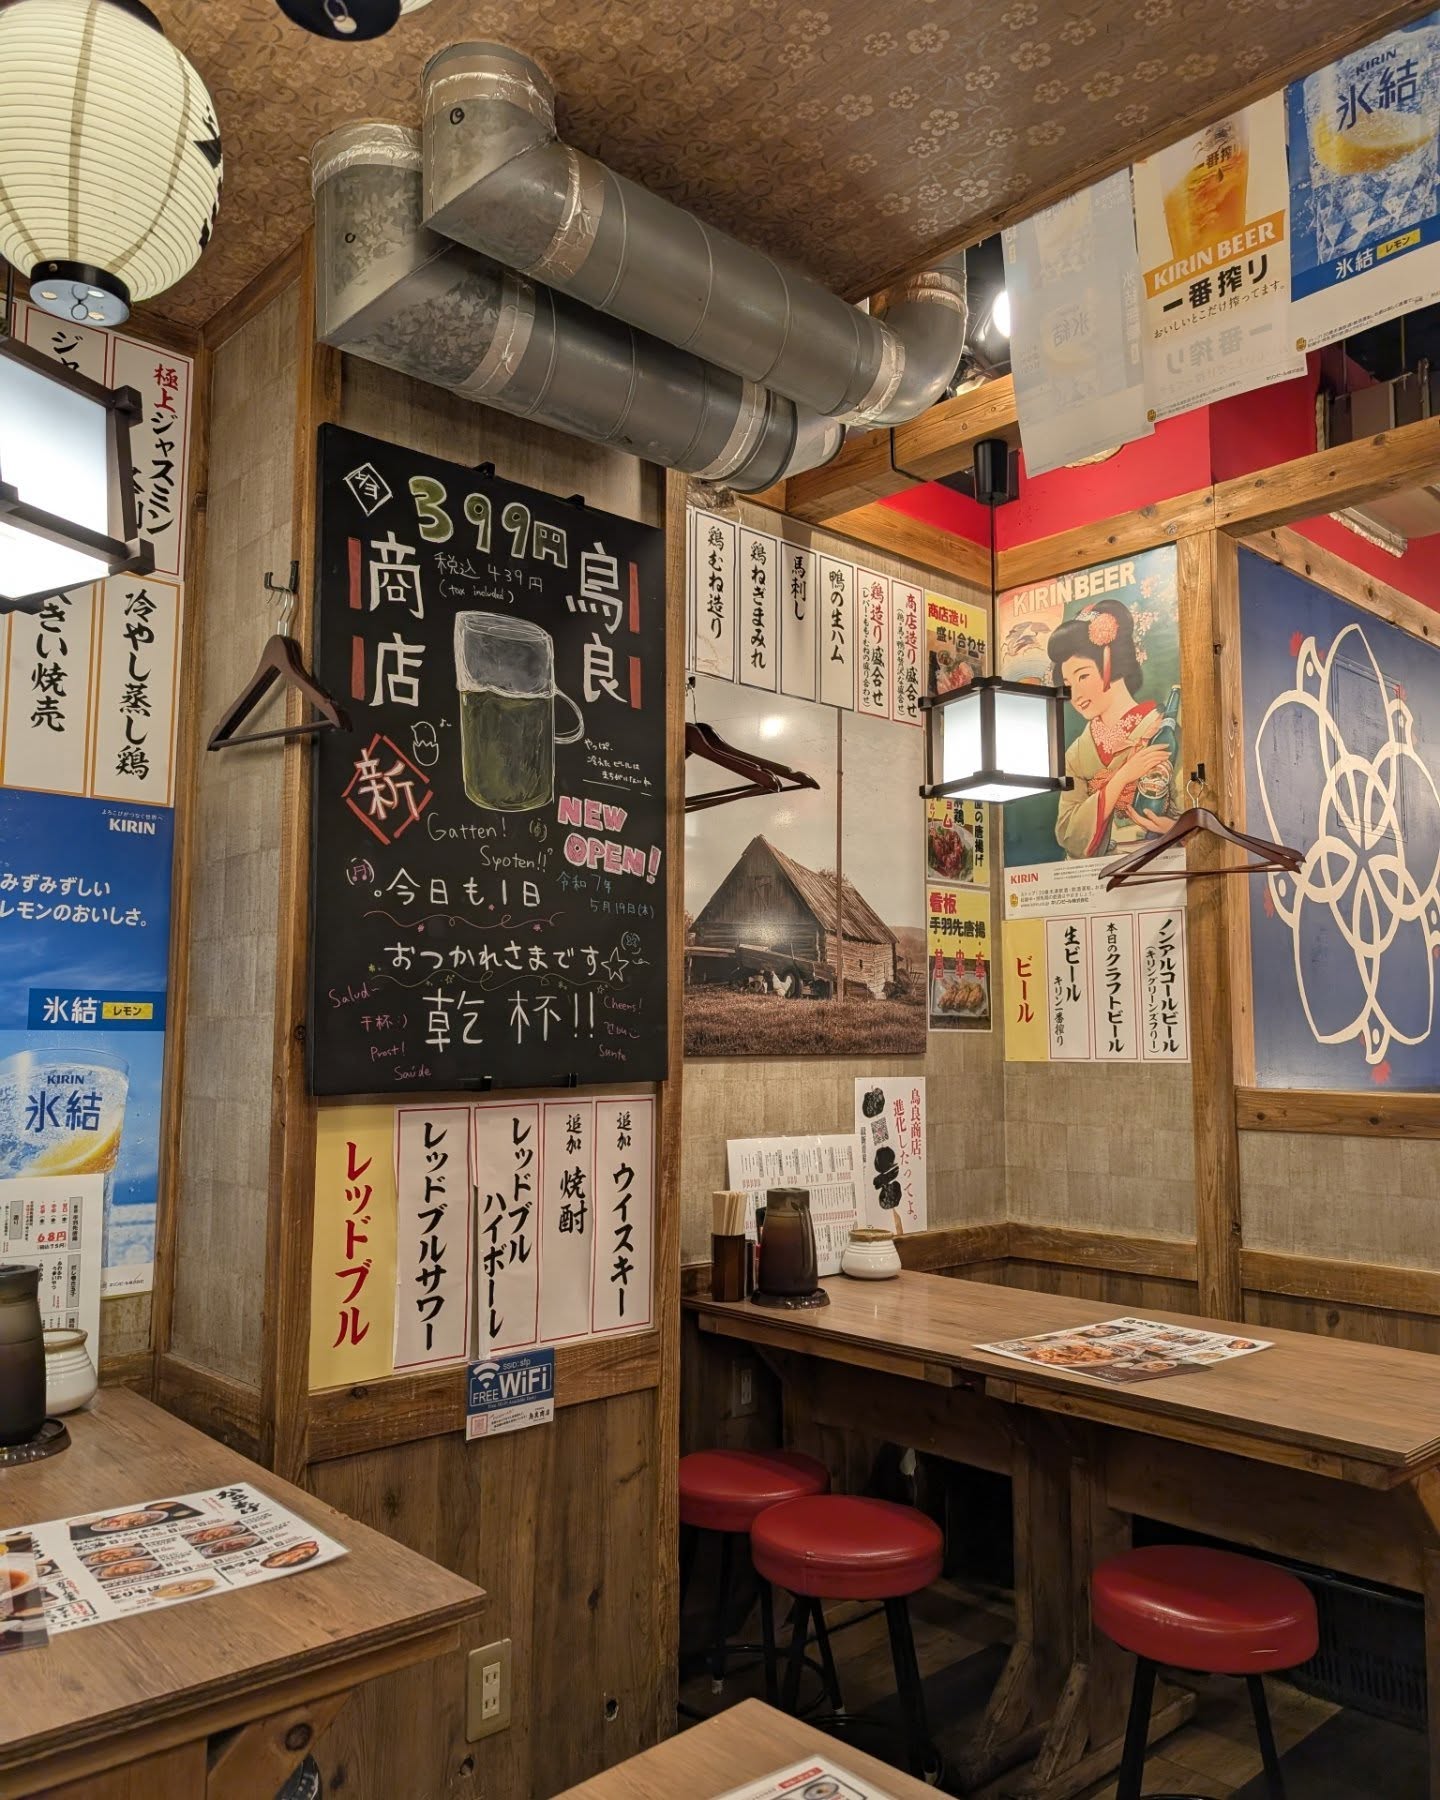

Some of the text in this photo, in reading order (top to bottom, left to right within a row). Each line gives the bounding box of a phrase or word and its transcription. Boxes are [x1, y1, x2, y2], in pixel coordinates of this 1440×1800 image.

[1336, 58, 1419, 132] 氷結
[1355, 48, 1397, 76] KIRIN
[1153, 220, 1276, 291] KIRIN BEER
[1163, 254, 1268, 313] 一番搾り
[1335, 235, 1411, 280] 氷結 レモン
[408, 476, 568, 568] 399円
[434, 552, 480, 579] 税込
[707, 525, 725, 639] 鶏むね造り
[791, 556, 807, 621] 馬刺し
[1013, 561, 1137, 616] KIRIN BEER
[750, 540, 767, 669] 鶏ねぎまみれ
[829, 568, 845, 665] 鴨の生ハム
[115, 588, 158, 781] 冷やし蒸し鶏
[349, 747, 421, 821] 新
[557, 795, 628, 833] NEW
[109, 818, 157, 836] KIRIN
[563, 834, 662, 885] OPEN!
[929, 892, 957, 914] 看板
[1010, 873, 1039, 885] KIRIN
[0, 900, 148, 927] レモンのおいしさ。
[1016, 956, 1035, 1024] ビール
[1064, 925, 1082, 1002] 生ビール
[1104, 922, 1125, 1053] 本日のクラフトビール
[1158, 918, 1180, 1053] ノンアルコールビール
[43, 995, 142, 1024] 氷結 レモン
[24, 1090, 103, 1134] 氷結
[47, 1074, 85, 1086] KIRIN
[507, 1117, 535, 1265] レッドブル
[558, 1112, 589, 1235] 追加 焼酎
[332, 1140, 374, 1350] レッドブル
[414, 1121, 449, 1351] レッドブルサワー
[610, 1110, 636, 1318] 追加 ウイスキー
[473, 1388, 499, 1405] FREE
[500, 1366, 547, 1399] WiFi
